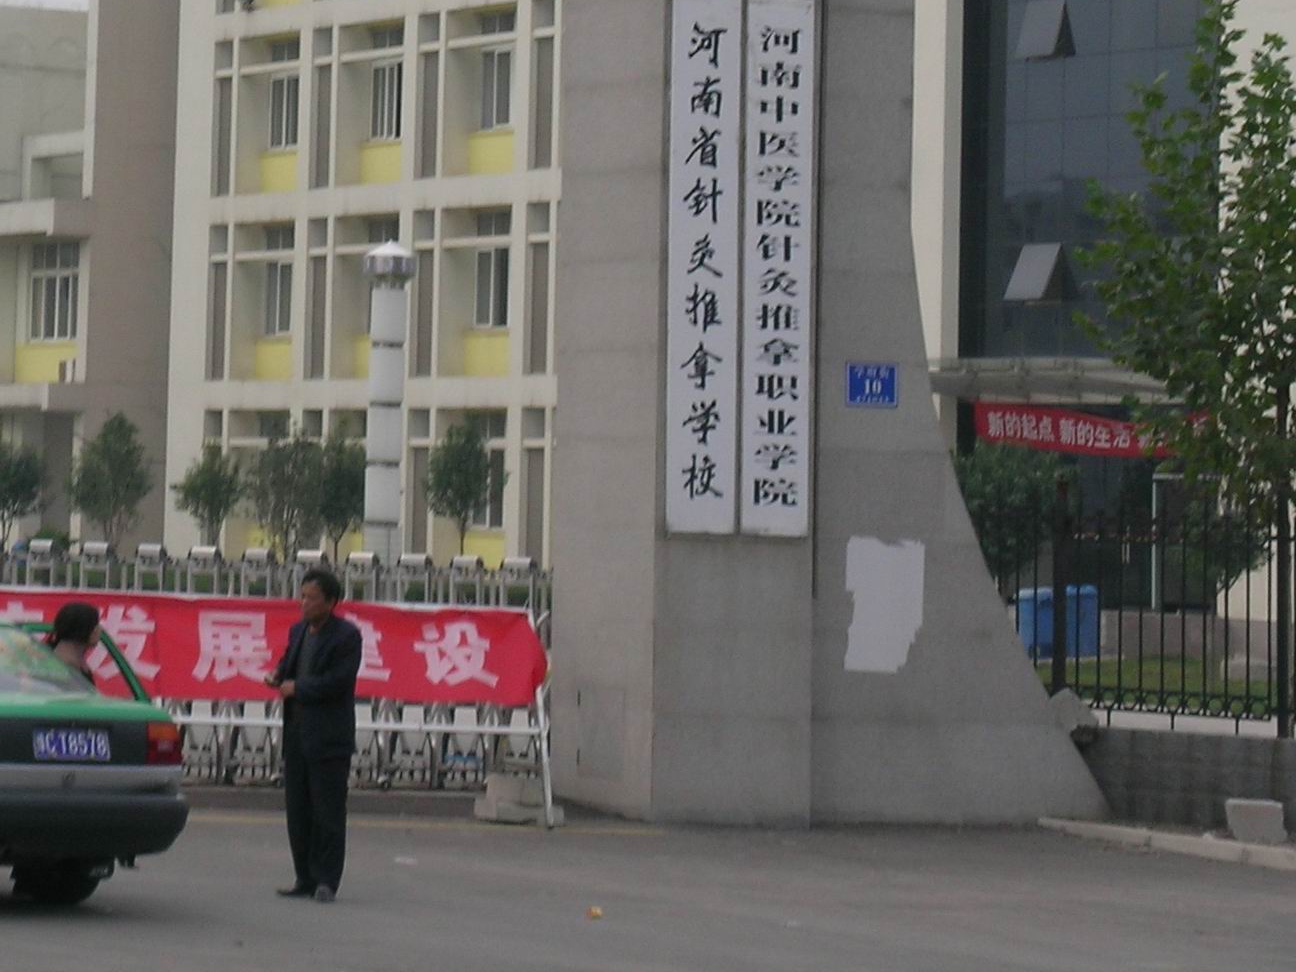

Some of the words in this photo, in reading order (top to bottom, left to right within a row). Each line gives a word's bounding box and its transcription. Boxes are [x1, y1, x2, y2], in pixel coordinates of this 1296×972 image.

[680, 21, 728, 500] 河南省针灸推拿学校
[753, 25, 801, 507] 河南中医学院针灸推拿职业学院
[986, 410, 1055, 441] 新的起点
[1059, 418, 1130, 448] 新的生活
